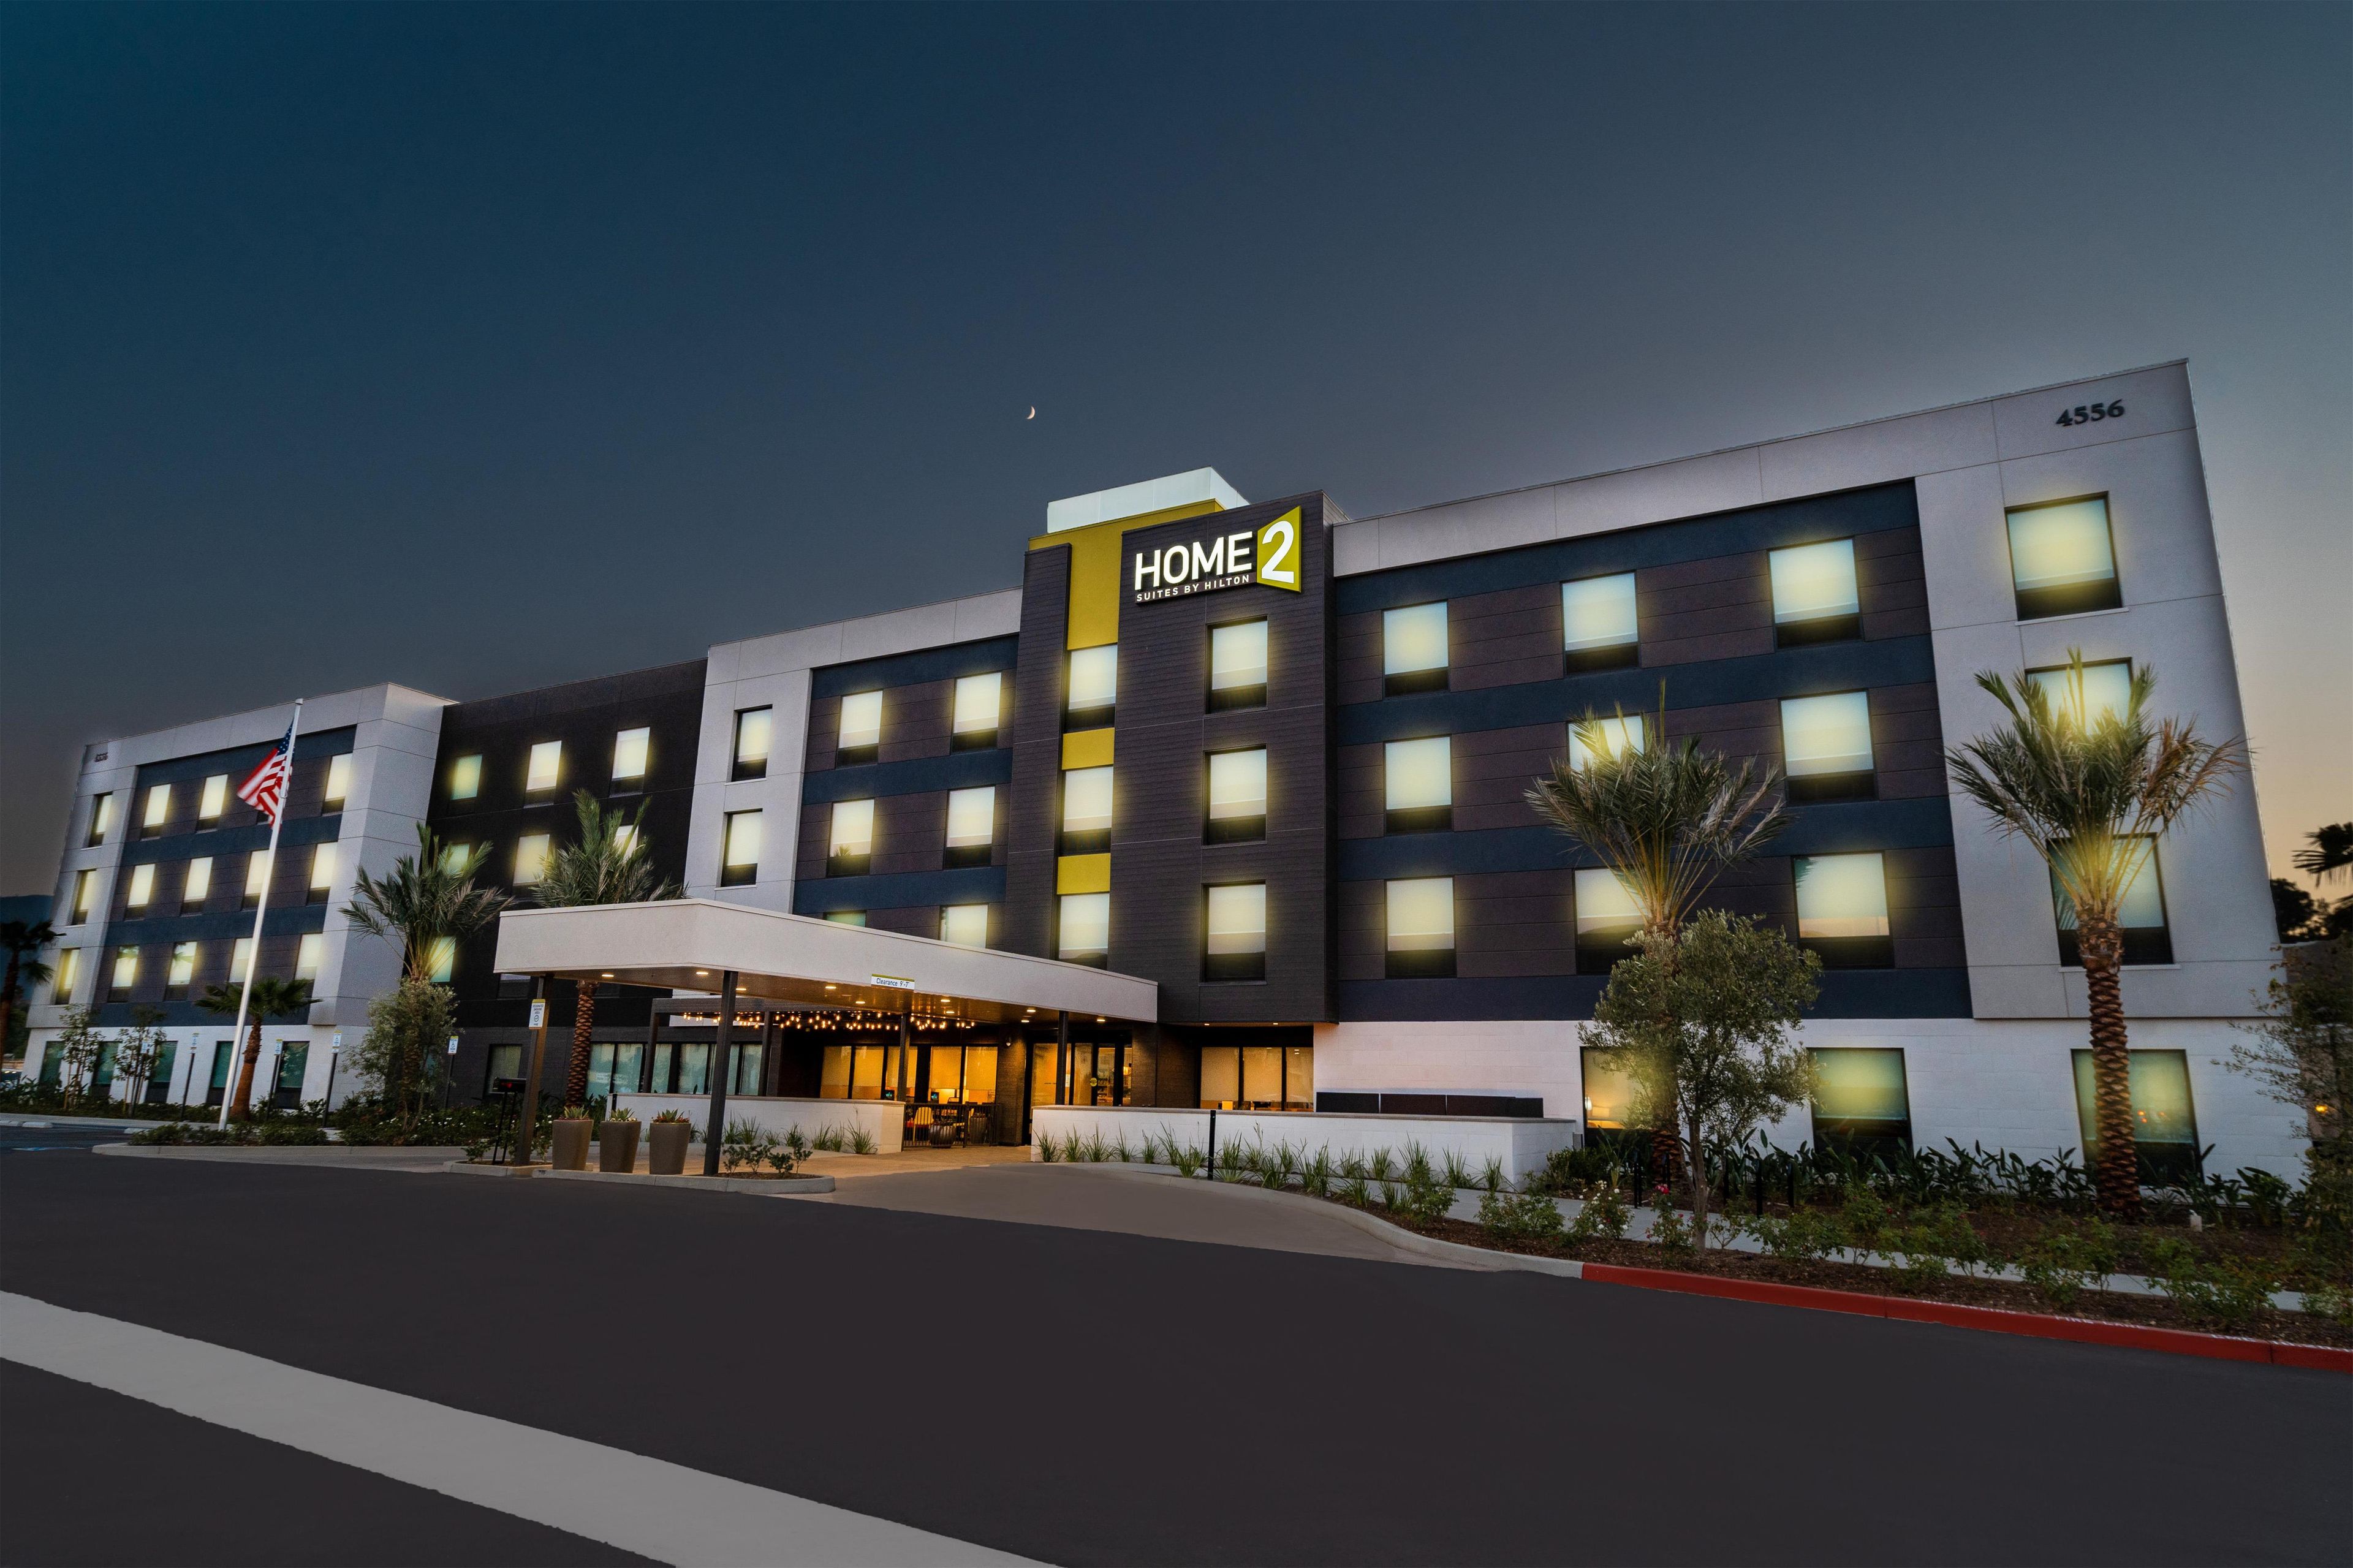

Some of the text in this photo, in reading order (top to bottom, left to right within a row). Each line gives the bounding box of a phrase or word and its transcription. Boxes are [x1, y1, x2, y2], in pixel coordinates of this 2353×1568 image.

[2056, 399, 2125, 427] 4556
[1134, 520, 1295, 591] HOME 2
[1137, 574, 1249, 602] SUITES BY HILTON
[876, 977, 898, 987] Clearance
